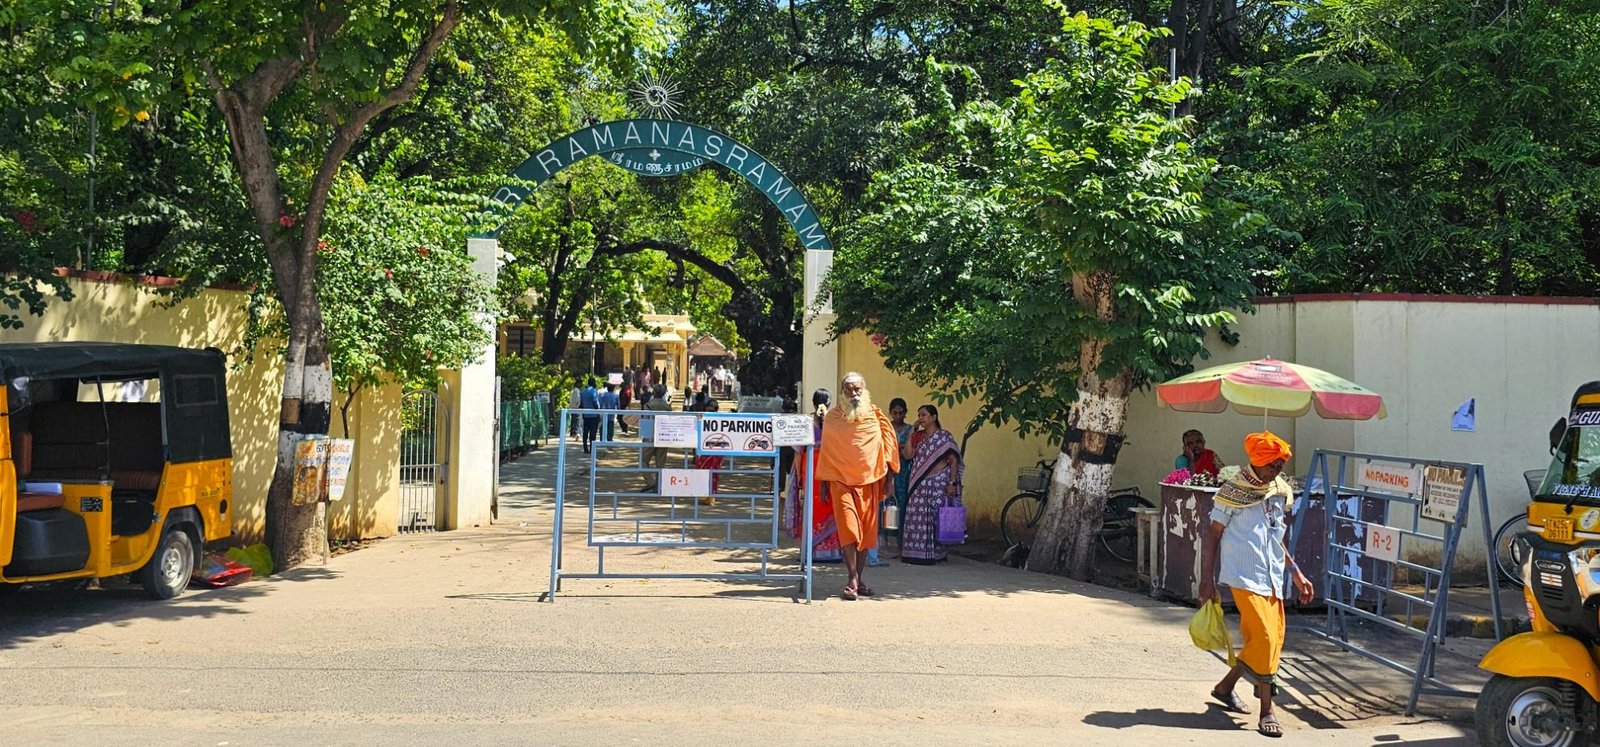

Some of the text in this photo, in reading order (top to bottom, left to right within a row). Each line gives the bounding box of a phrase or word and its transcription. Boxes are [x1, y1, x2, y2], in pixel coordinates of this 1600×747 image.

[536, 121, 826, 247] RAMANASRAMAM
[703, 420, 773, 434] NO PARKING
[1373, 531, 1392, 551] R-2
